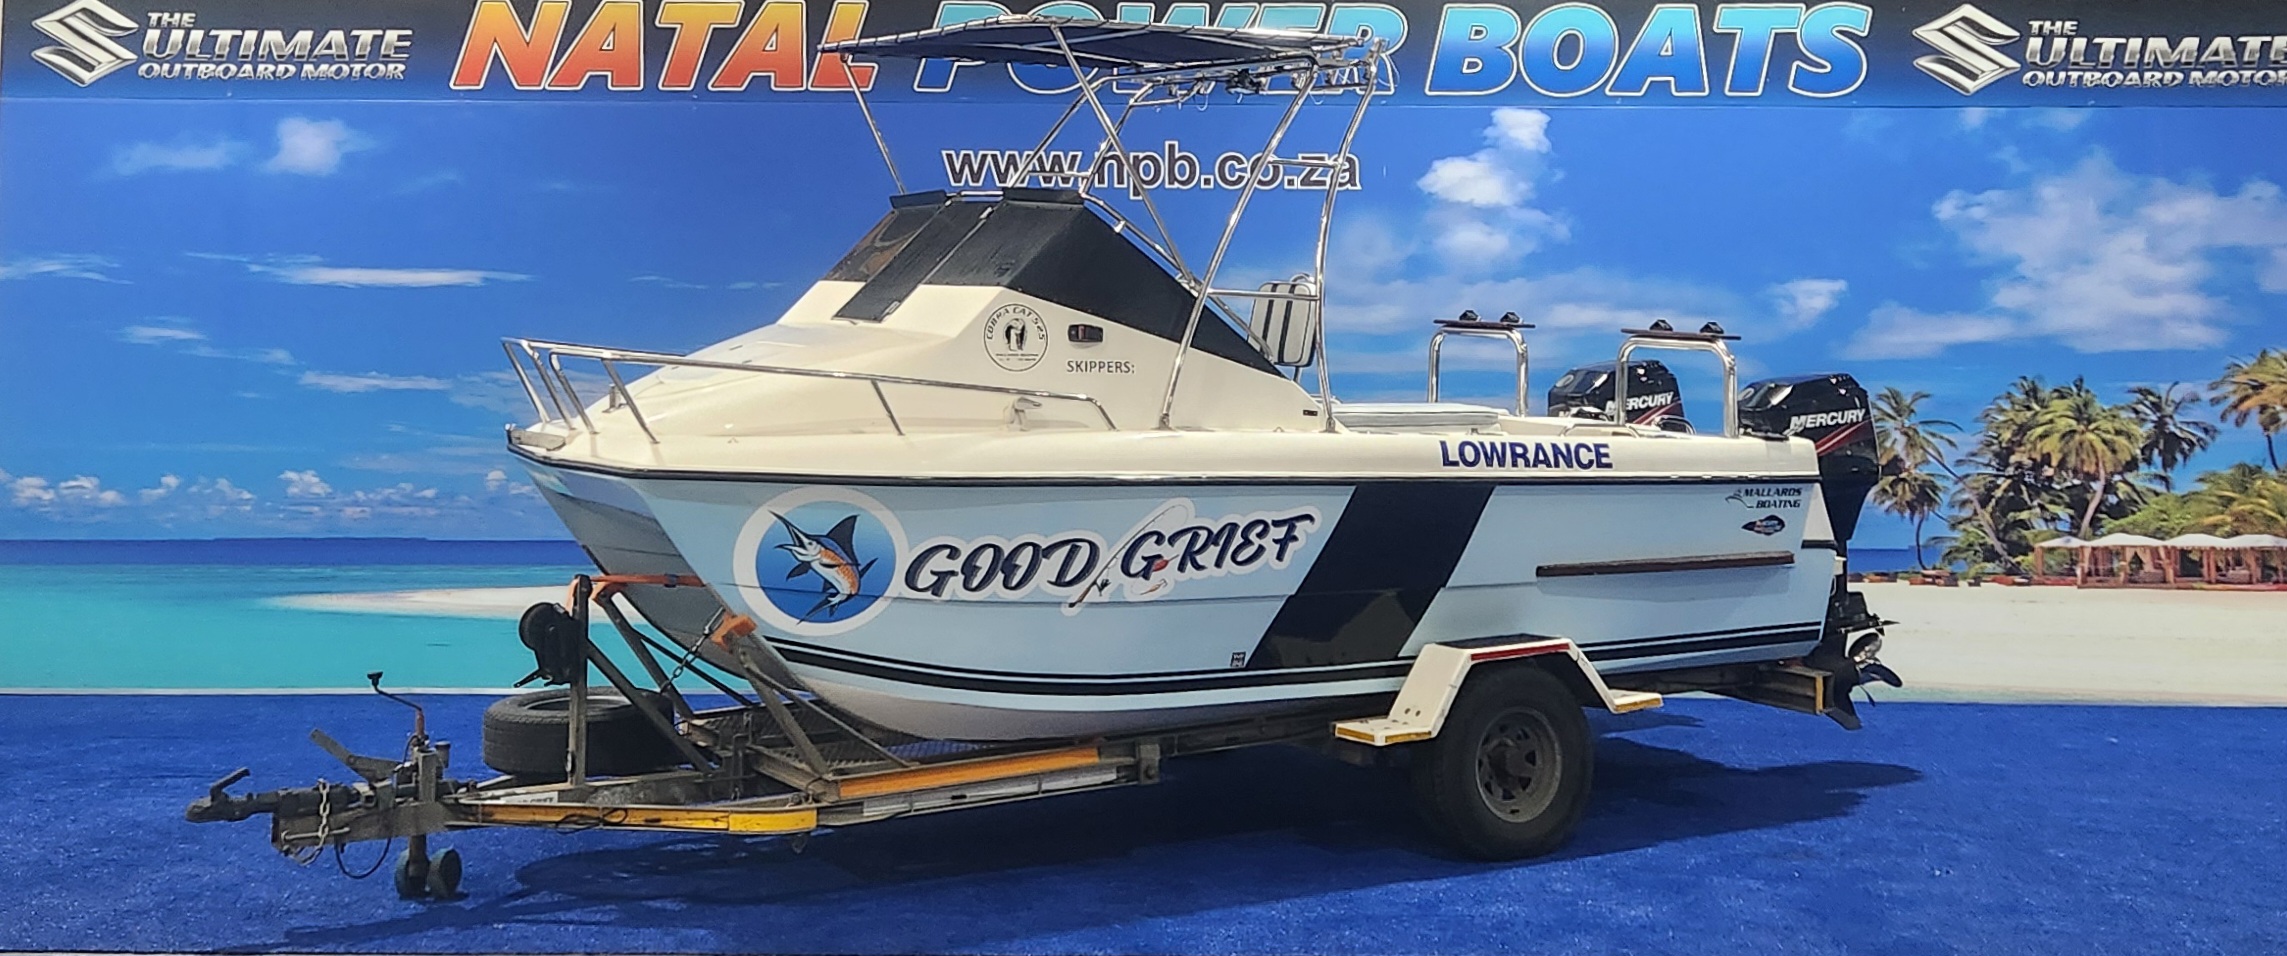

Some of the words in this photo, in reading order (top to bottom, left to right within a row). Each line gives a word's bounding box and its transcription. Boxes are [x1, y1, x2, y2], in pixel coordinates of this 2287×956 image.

[147, 12, 196, 28] THE
[2028, 20, 2079, 35] THE
[142, 28, 413, 62] ULTIMATE
[449, 0, 878, 91] NATAL
[1424, 1, 1874, 98] BOATS
[138, 63, 297, 80] OUTBOARD
[300, 63, 406, 80] MOTOR
[2022, 70, 2184, 88] OUTBOARD
[1012, 307, 1032, 317] CAT
[1066, 360, 1135, 374] SKIPPERS:
[1605, 391, 1674, 415] MERCURY
[1789, 408, 1866, 431] MERCURY
[1439, 440, 1613, 470] LOWRANCE
[1743, 487, 1802, 497] MALLARDS
[1755, 499, 1801, 509] BOATING
[904, 537, 1100, 597] GOOD
[1120, 513, 1315, 580] GRIEF
